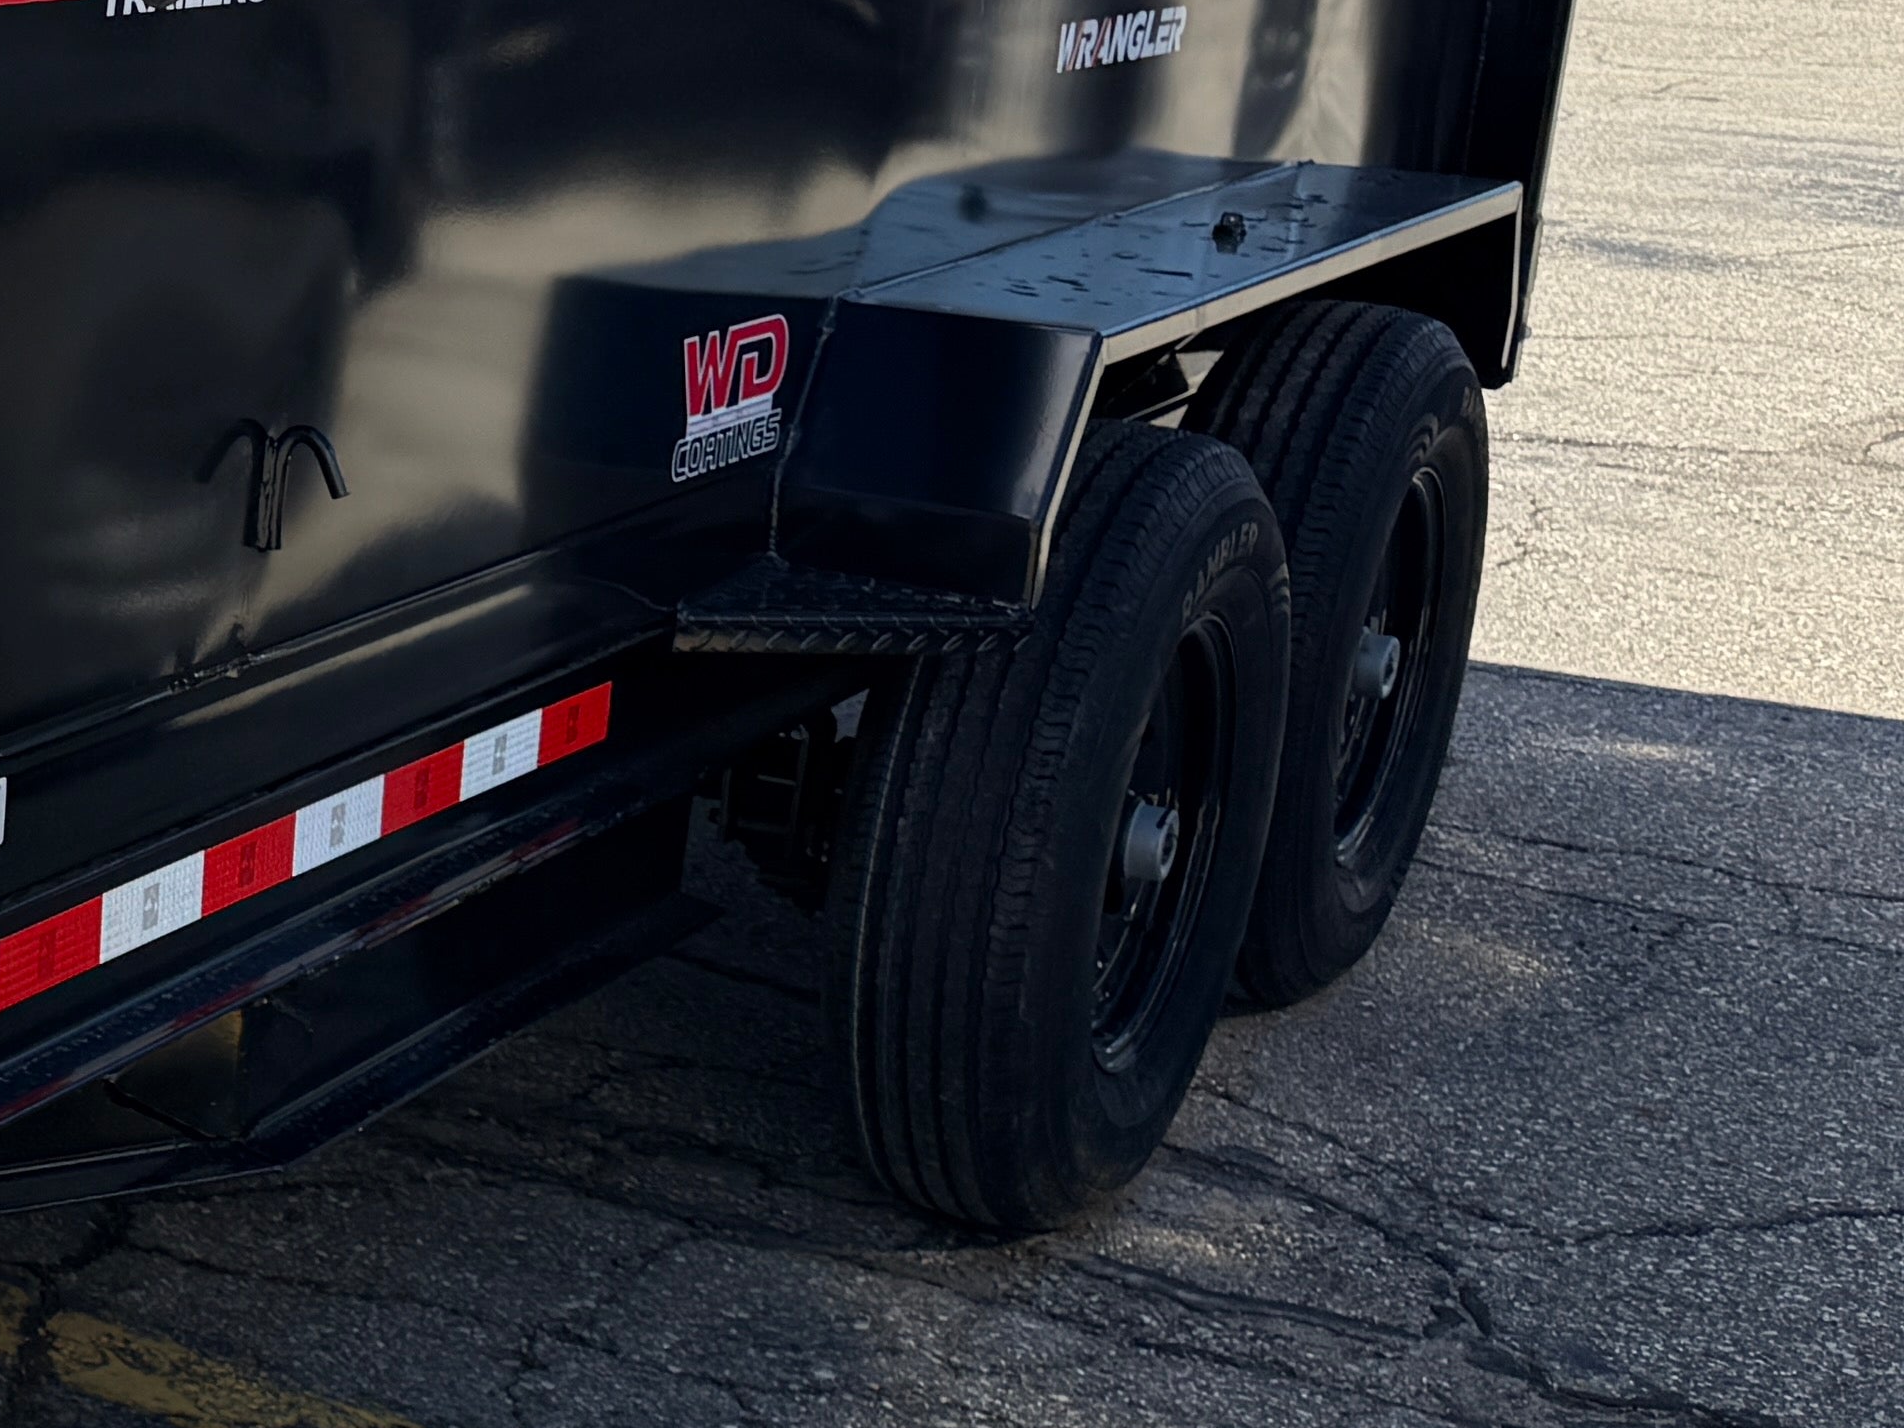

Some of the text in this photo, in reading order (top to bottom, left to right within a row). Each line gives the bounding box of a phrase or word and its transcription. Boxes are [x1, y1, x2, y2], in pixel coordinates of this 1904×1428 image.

[1056, 5, 1188, 73] WRANGLER
[683, 313, 790, 419] WD
[672, 408, 782, 482] COATINGS
